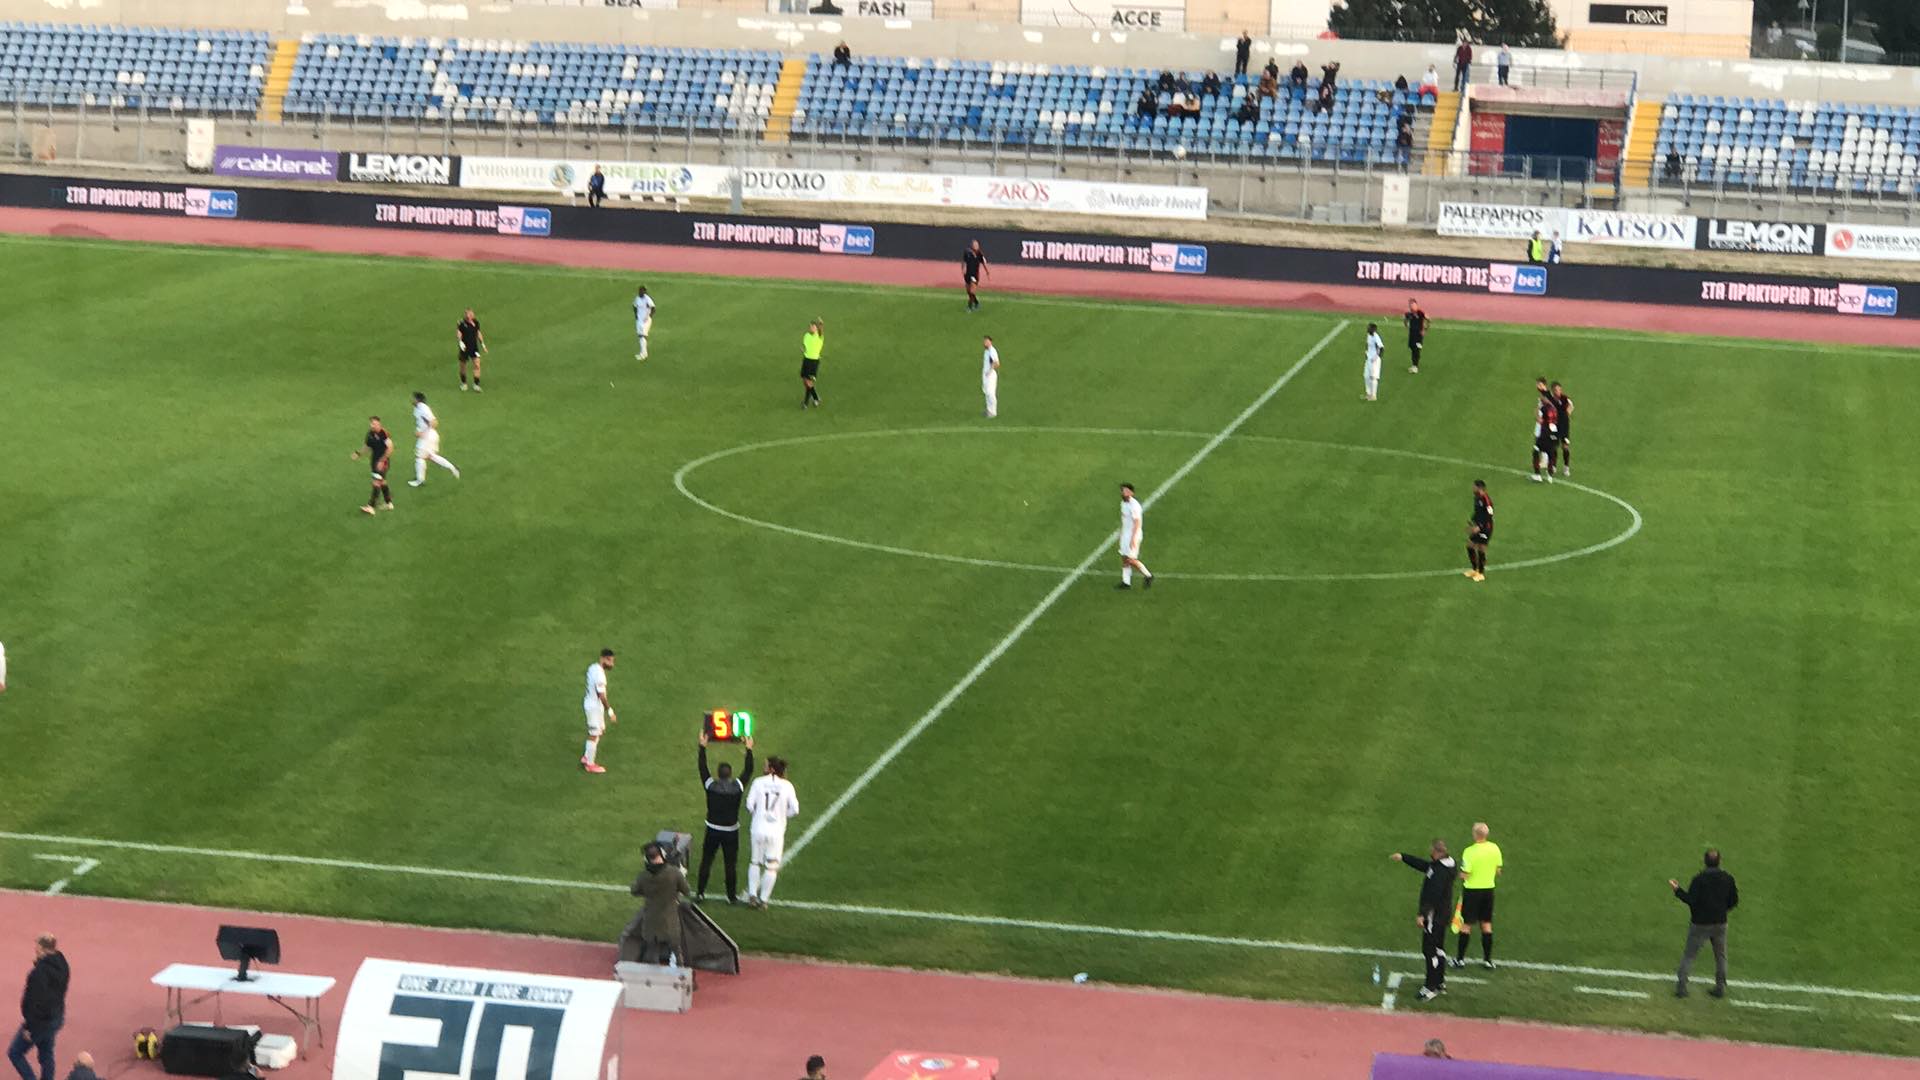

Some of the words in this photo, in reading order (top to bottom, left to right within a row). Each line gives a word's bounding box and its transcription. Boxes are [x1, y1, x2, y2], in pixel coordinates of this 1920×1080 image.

[858, 0, 906, 16] FASH
[1111, 10, 1162, 27] ACCE
[1626, 9, 1667, 24] next
[236, 152, 332, 176] cablenet
[349, 152, 450, 178] LEMON
[632, 180, 666, 192] AIR
[743, 171, 826, 191] DUOMO
[211, 197, 234, 210] bet
[524, 214, 548, 229] bet
[1443, 204, 1544, 224] PALEPAPHOS
[846, 233, 871, 247] bet
[1708, 219, 1815, 246] LEMON
[1857, 233, 1900, 245] AMBER
[1178, 251, 1203, 266] bet
[1517, 272, 1543, 288] bet
[1867, 293, 1894, 308] bet
[712, 710, 728, 737] 5
[765, 791, 780, 811] 17
